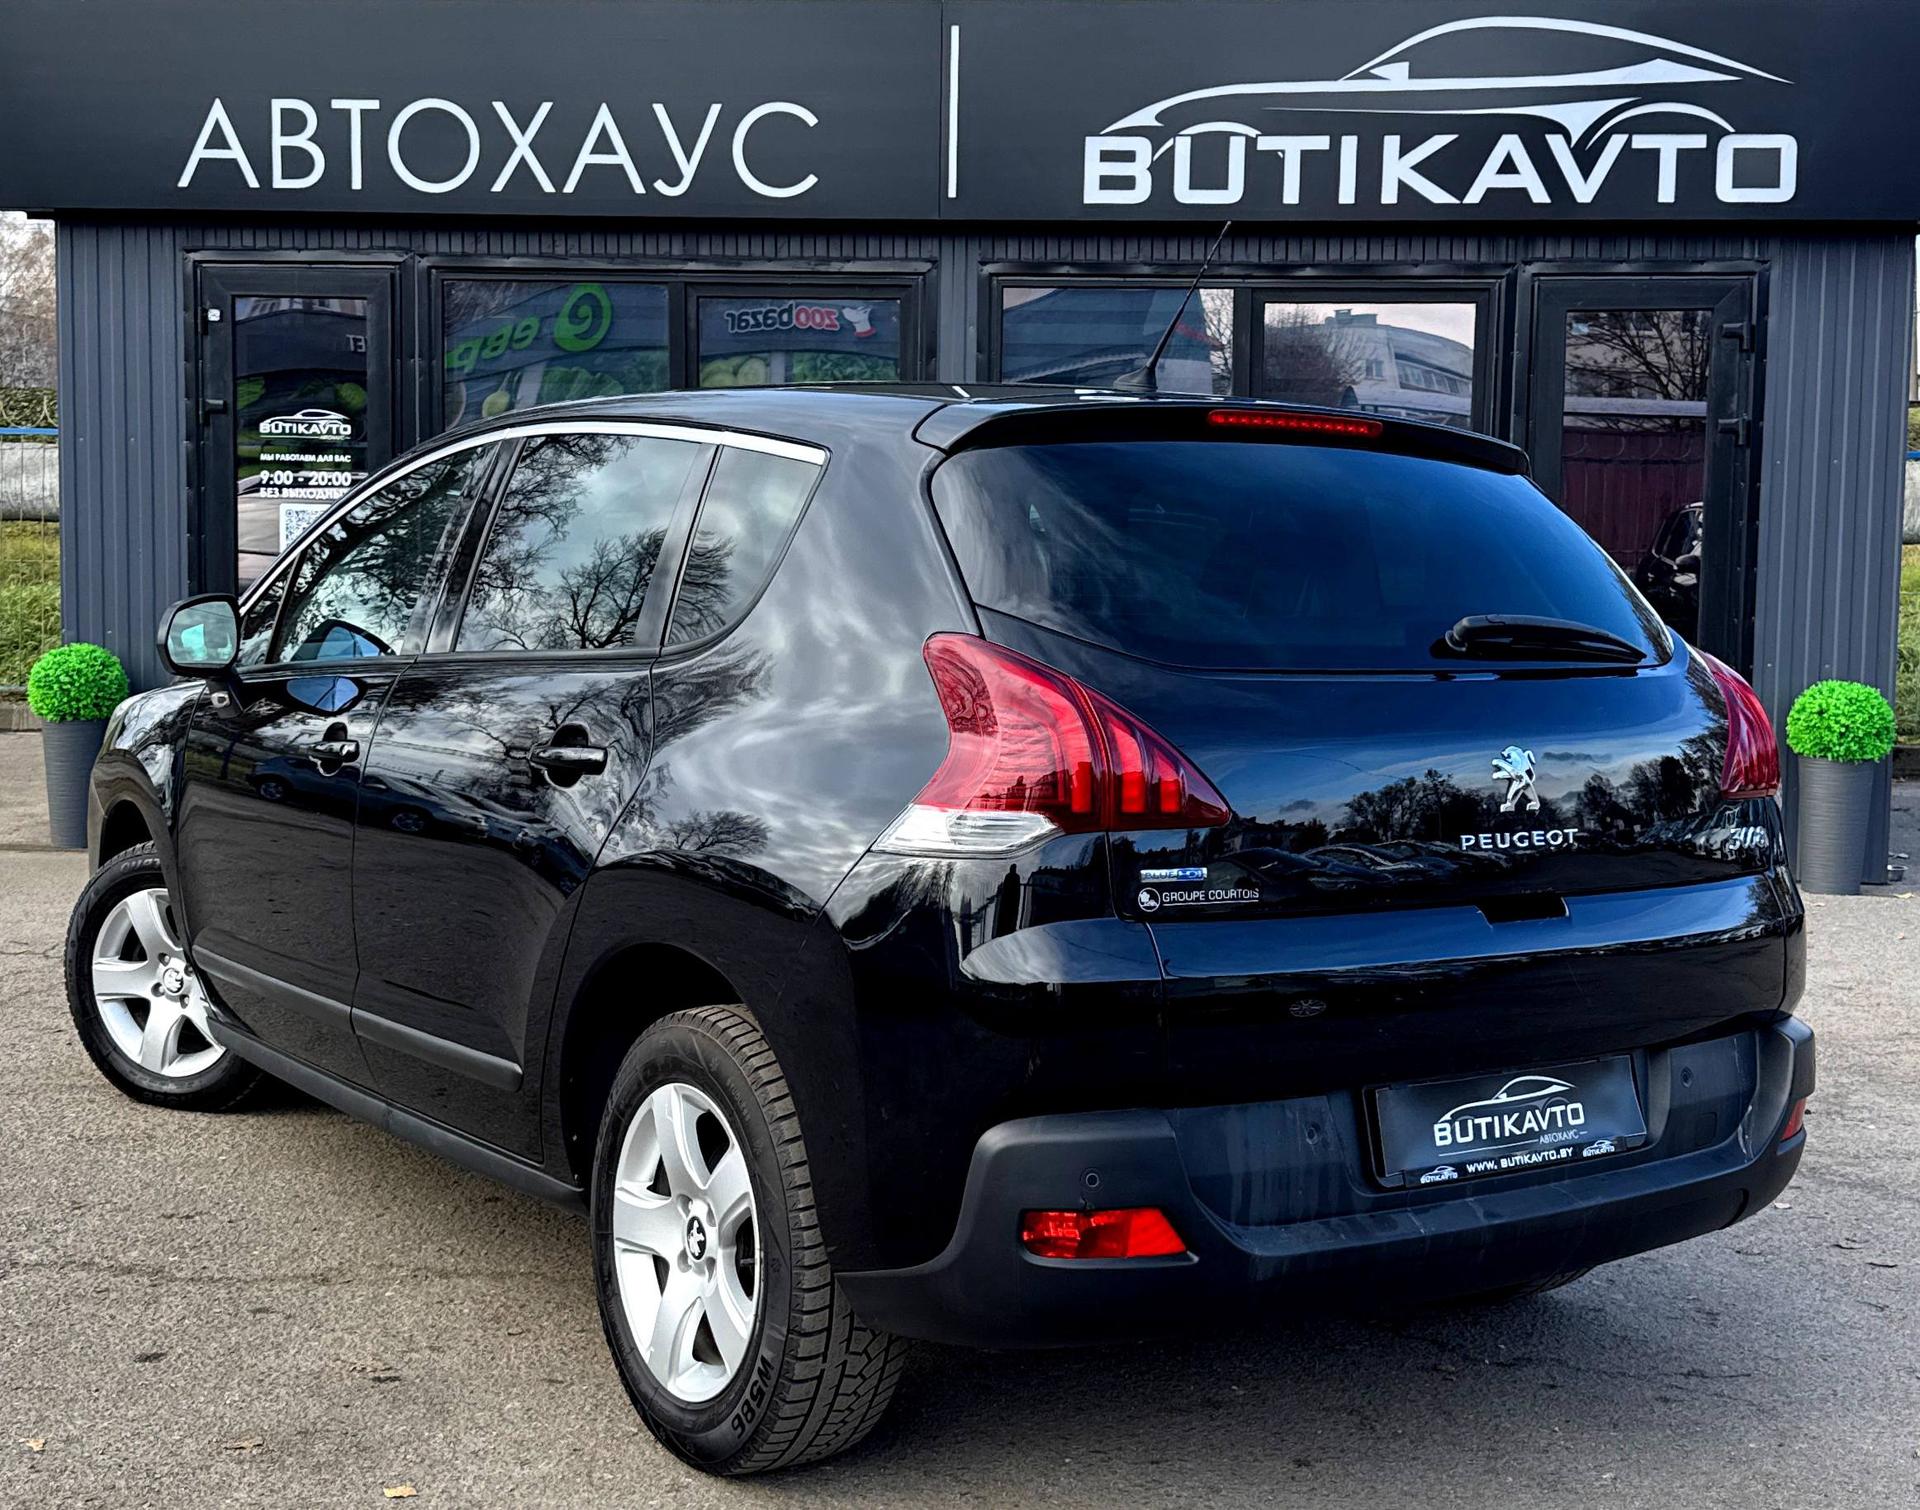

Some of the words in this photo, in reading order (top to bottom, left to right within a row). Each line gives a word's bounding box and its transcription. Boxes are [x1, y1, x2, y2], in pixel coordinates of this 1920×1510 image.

[178, 97, 818, 198] АВТОХАУС
[1083, 133, 1797, 205] BUTIKAVTO
[259, 422, 351, 435] BUTIKAVTO
[260, 453, 274, 461] МЫ
[275, 453, 316, 462] РАБОТАЕМ
[317, 454, 334, 462] ДЛЯ
[334, 455, 352, 463] ВАС
[260, 470, 294, 485] 9:00
[308, 471, 352, 486] 20:00
[260, 487, 280, 498] БЕЗ
[1460, 828, 1578, 850] PEUGEOT
[1162, 890, 1205, 902] GROUPE
[1208, 888, 1260, 900] COURTOIS
[1433, 1102, 1585, 1147] BUTIKAVTO
[1539, 1129, 1580, 1144] АВТОХАУС
[731, 1355, 774, 1439] W586
